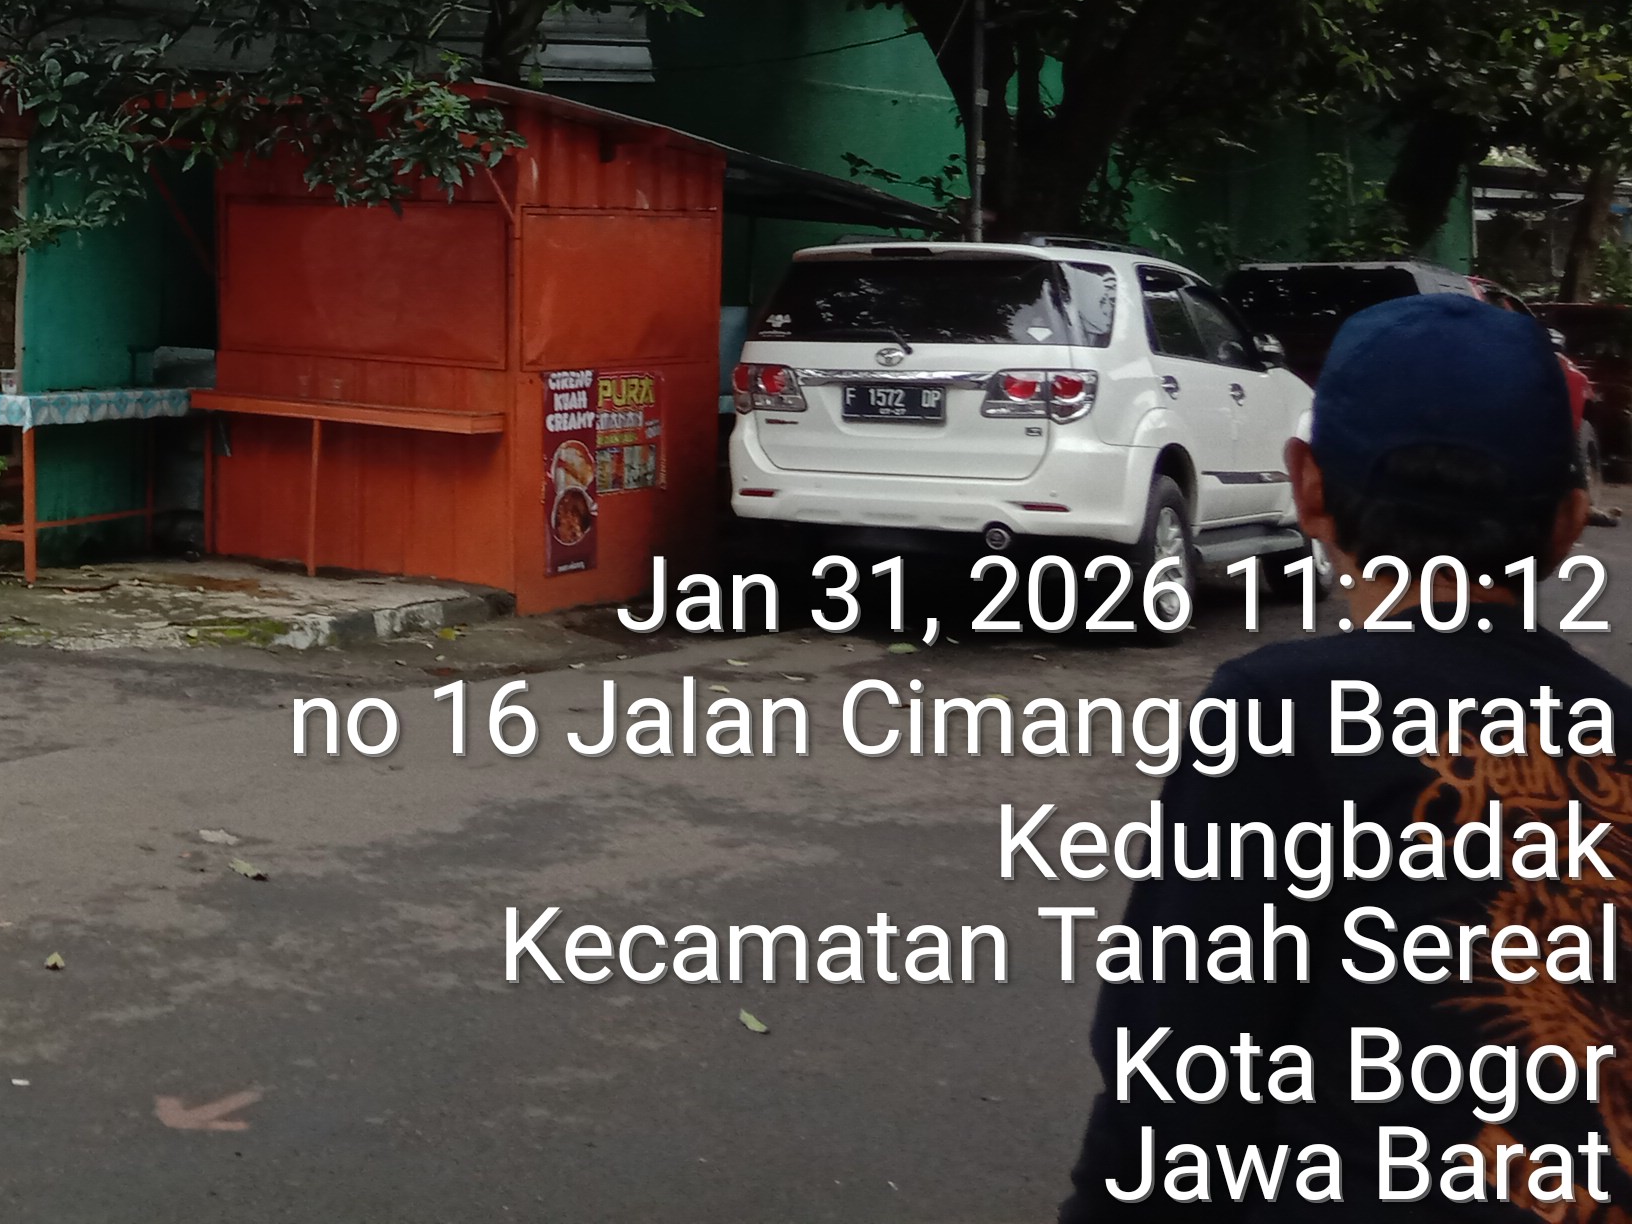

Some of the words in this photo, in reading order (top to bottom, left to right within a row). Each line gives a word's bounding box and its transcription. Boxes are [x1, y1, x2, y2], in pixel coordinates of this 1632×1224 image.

[846, 387, 856, 406] F
[868, 388, 905, 407] 1572
[921, 389, 941, 408] DP
[546, 411, 595, 432] CREAMY
